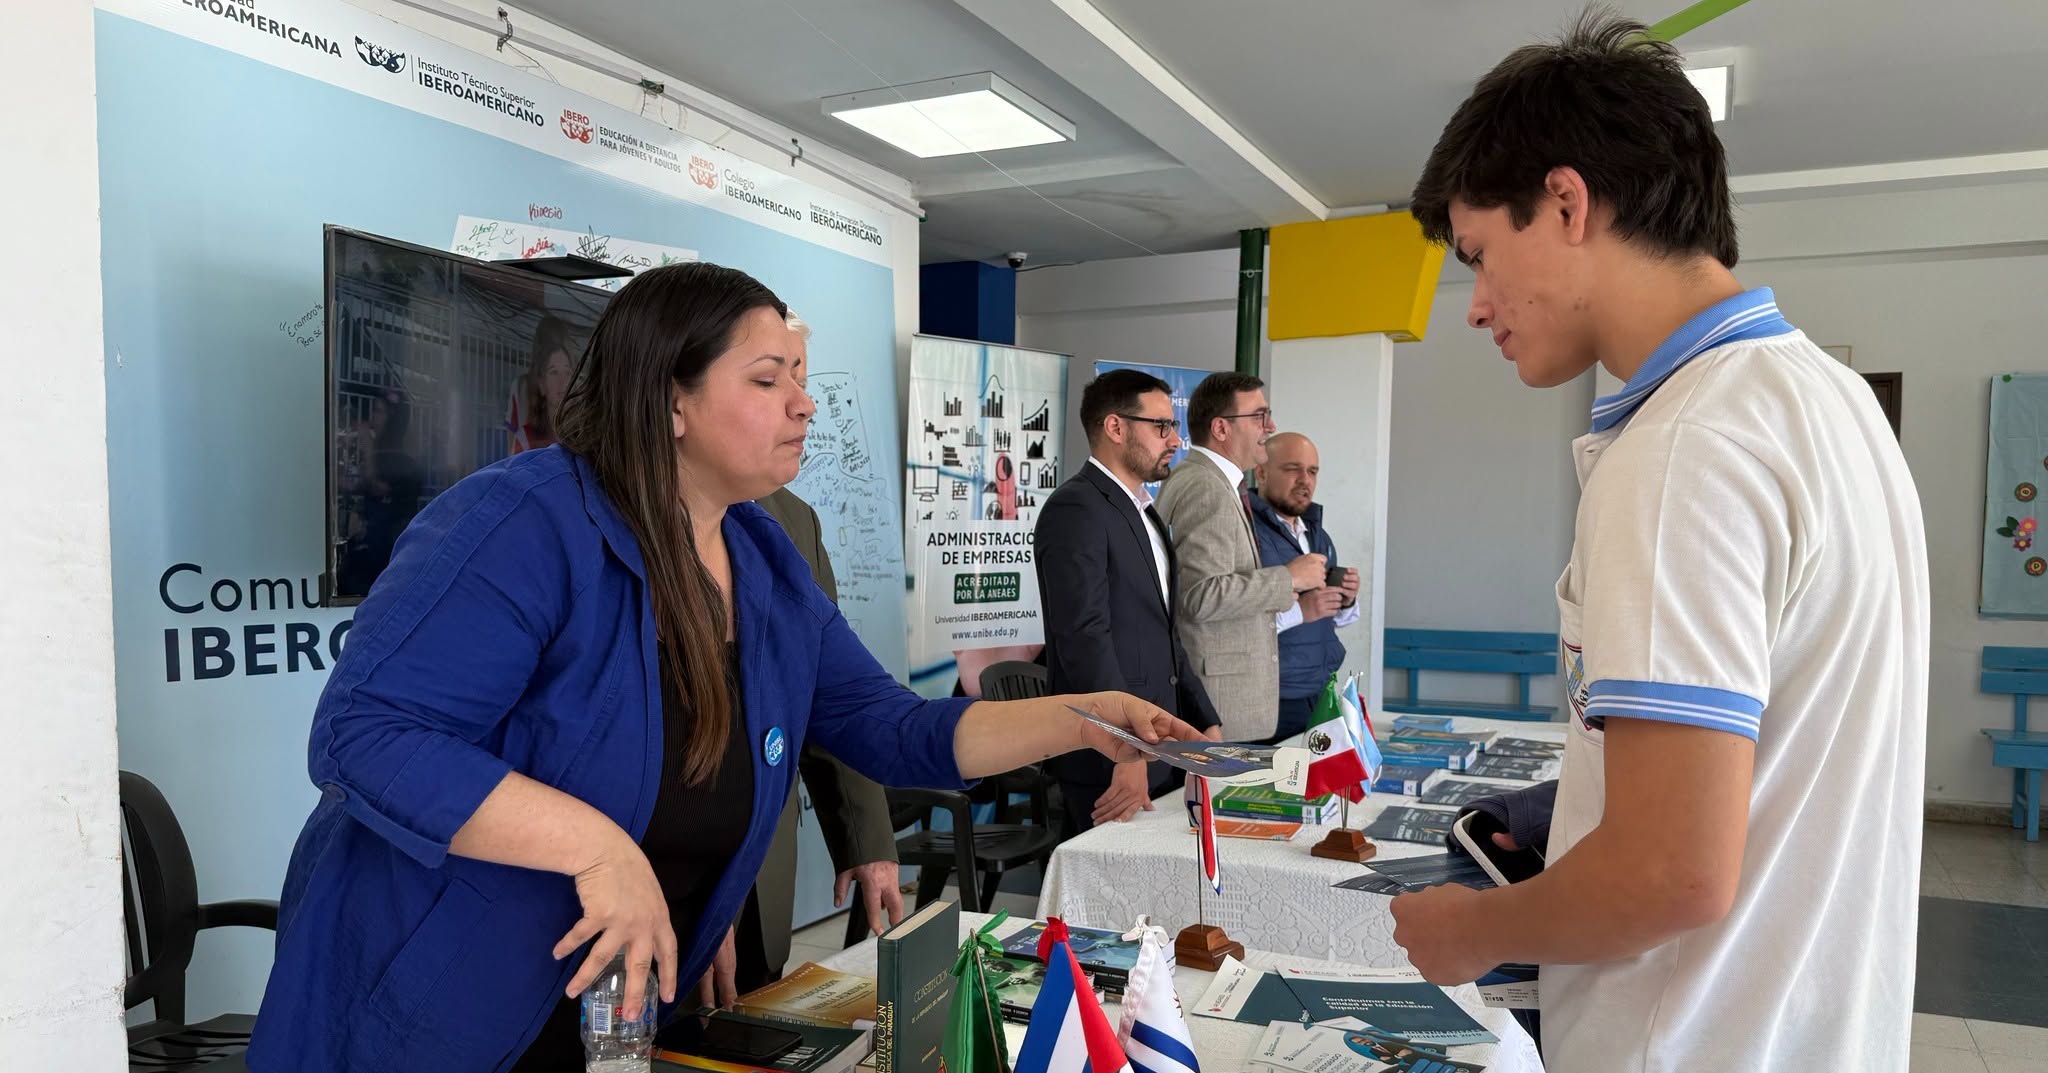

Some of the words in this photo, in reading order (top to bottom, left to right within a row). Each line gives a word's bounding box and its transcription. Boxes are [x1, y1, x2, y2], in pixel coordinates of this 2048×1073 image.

[417, 57, 460, 81] Instituto
[461, 72, 498, 95] Técnico
[500, 86, 535, 109] Superior
[418, 71, 544, 127] IBEROAMERICANO
[563, 109, 590, 126] IBERO
[599, 126, 638, 146] EDUCACIÓN
[639, 141, 645, 150] A
[645, 142, 679, 162] DISTANCIA
[600, 138, 618, 153] PARA
[619, 143, 647, 161] JÓVENES
[648, 154, 653, 163] Y
[654, 157, 681, 174] ADULTOS
[691, 156, 715, 171] IBERO
[724, 169, 755, 191] Colegio
[725, 184, 802, 221] IBEROAMERICANO
[810, 211, 882, 246] IBEROAMERICANO
[942, 551, 959, 565] DE
[963, 550, 1031, 565] EMPRESAS
[956, 575, 1017, 587] ACREDITADA
[956, 589, 972, 601] POR
[974, 588, 985, 600] LA
[987, 587, 1016, 599] ANEAES
[935, 614, 971, 624] Universidad
[970, 610, 1037, 622] IBEROAMERICANA
[952, 626, 1019, 640] www.unibe.edu.py
[886, 1000, 894, 1036] PARAGUAY
[876, 1005, 887, 1073] STITUCION
